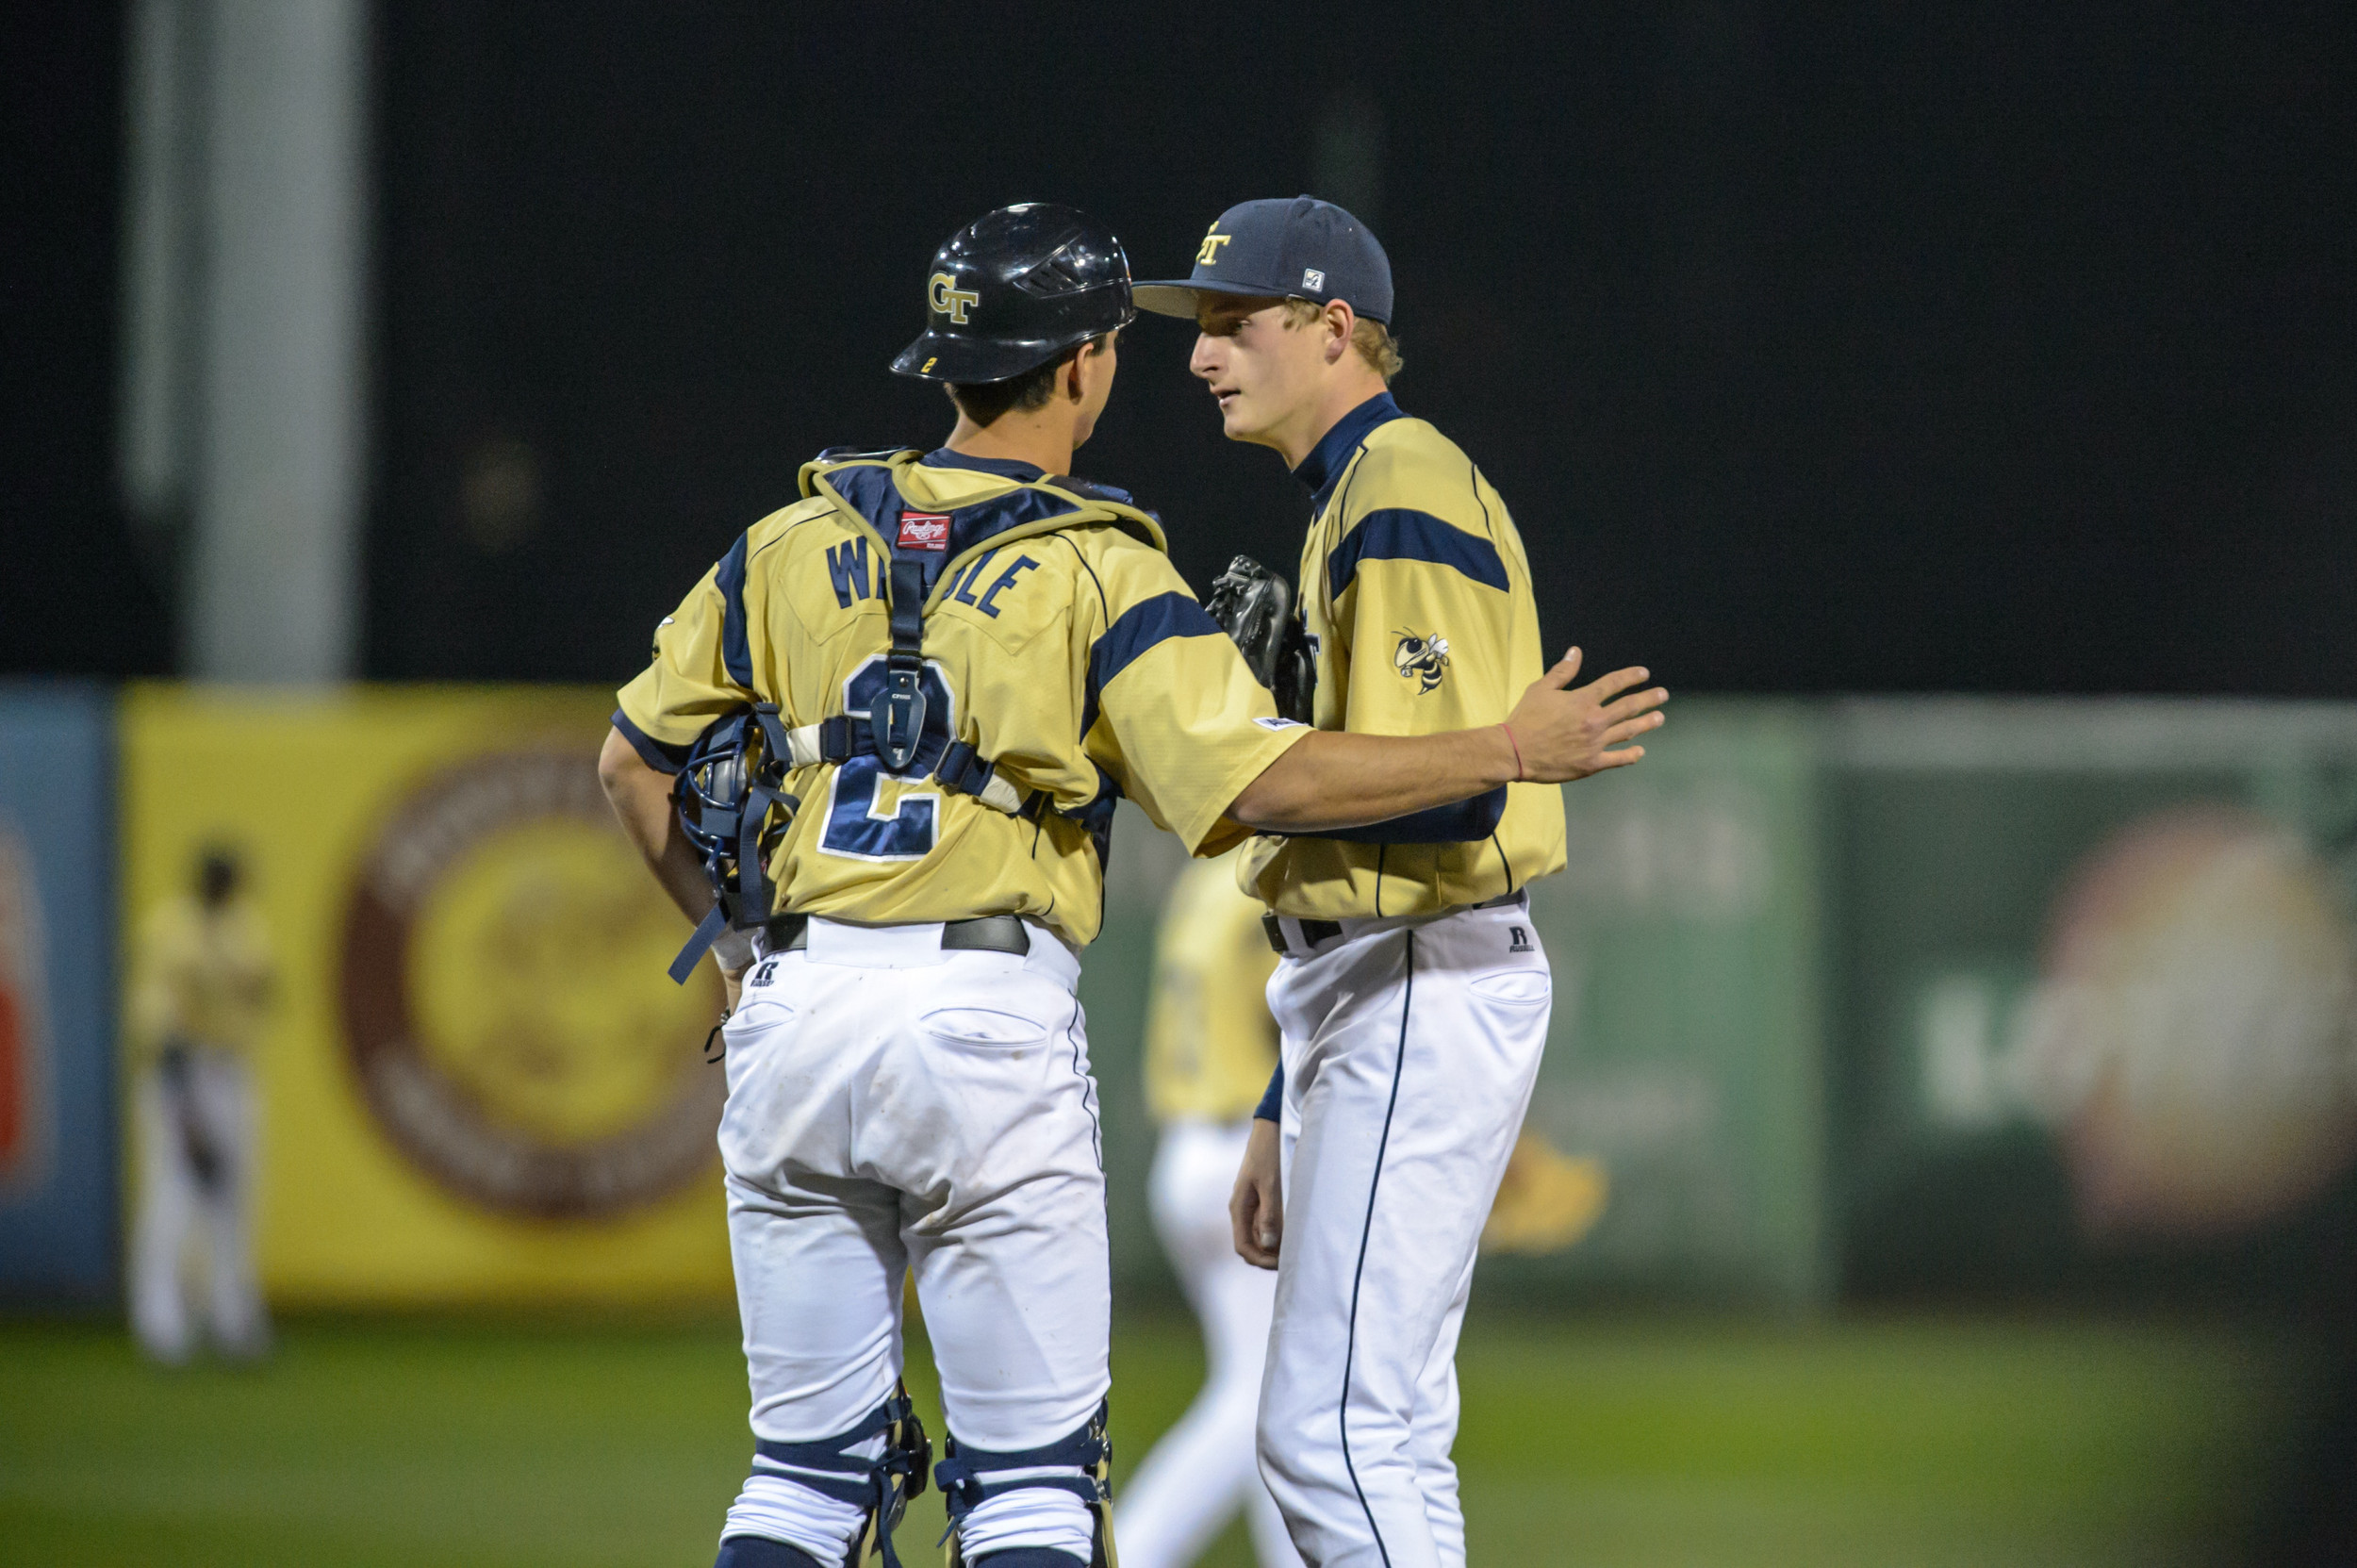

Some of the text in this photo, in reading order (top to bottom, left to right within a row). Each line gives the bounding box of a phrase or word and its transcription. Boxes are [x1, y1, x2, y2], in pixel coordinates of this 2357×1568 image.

[929, 272, 979, 324] GT
[921, 357, 938, 373] 2
[817, 653, 956, 862] 2
